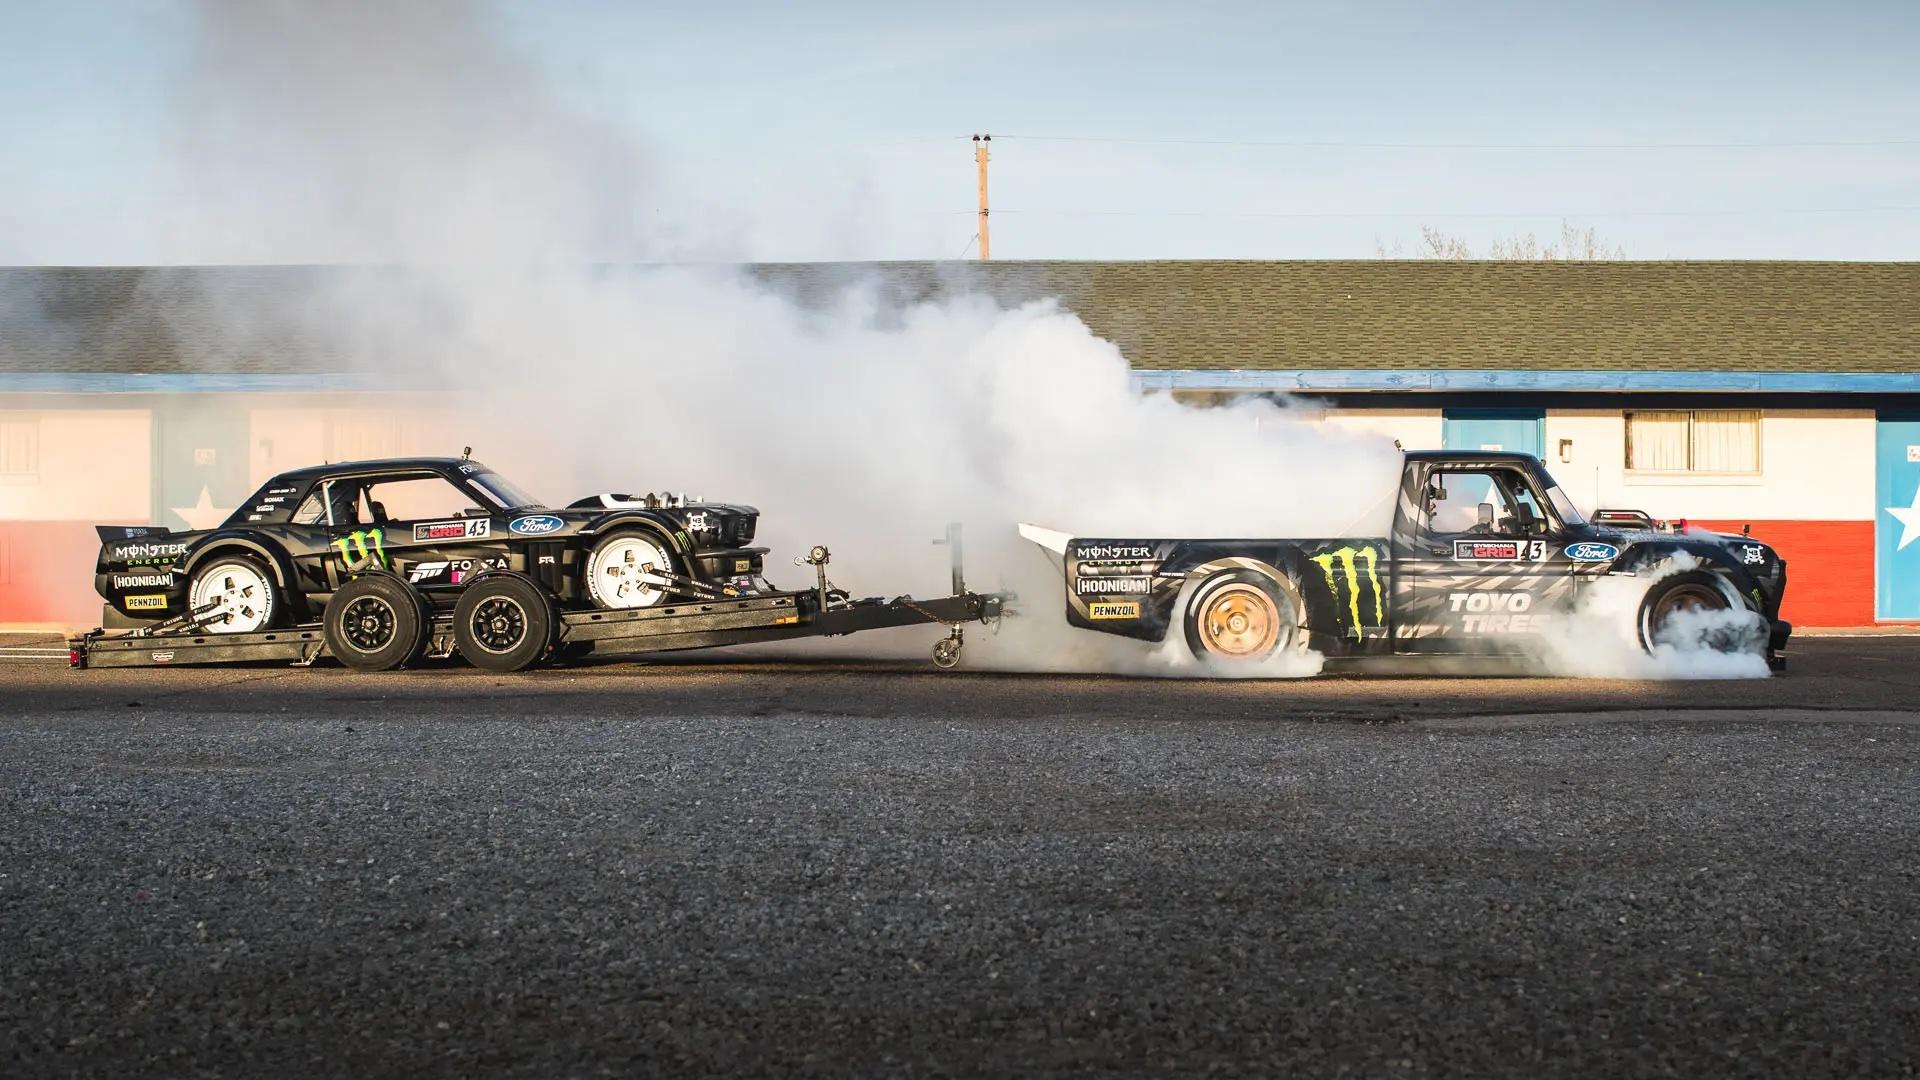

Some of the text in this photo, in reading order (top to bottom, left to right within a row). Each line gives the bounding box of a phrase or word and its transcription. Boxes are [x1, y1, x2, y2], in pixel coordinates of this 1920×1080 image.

[467, 520, 487, 537] 43
[519, 517, 554, 532] Ford
[115, 543, 187, 559] MONSTER
[1077, 546, 1151, 559] MONSTER
[1574, 544, 1609, 558] Ford
[127, 557, 178, 565] ENERGY
[450, 558, 508, 571] FOZA
[114, 573, 174, 588] [HOONIGAN]
[1077, 577, 1151, 594] [HOONIGAN]
[129, 597, 164, 607] PENNZOIL
[1449, 592, 1532, 613] TOYO
[1093, 605, 1136, 616] PENNZOIL
[1462, 614, 1551, 633] TIRES
